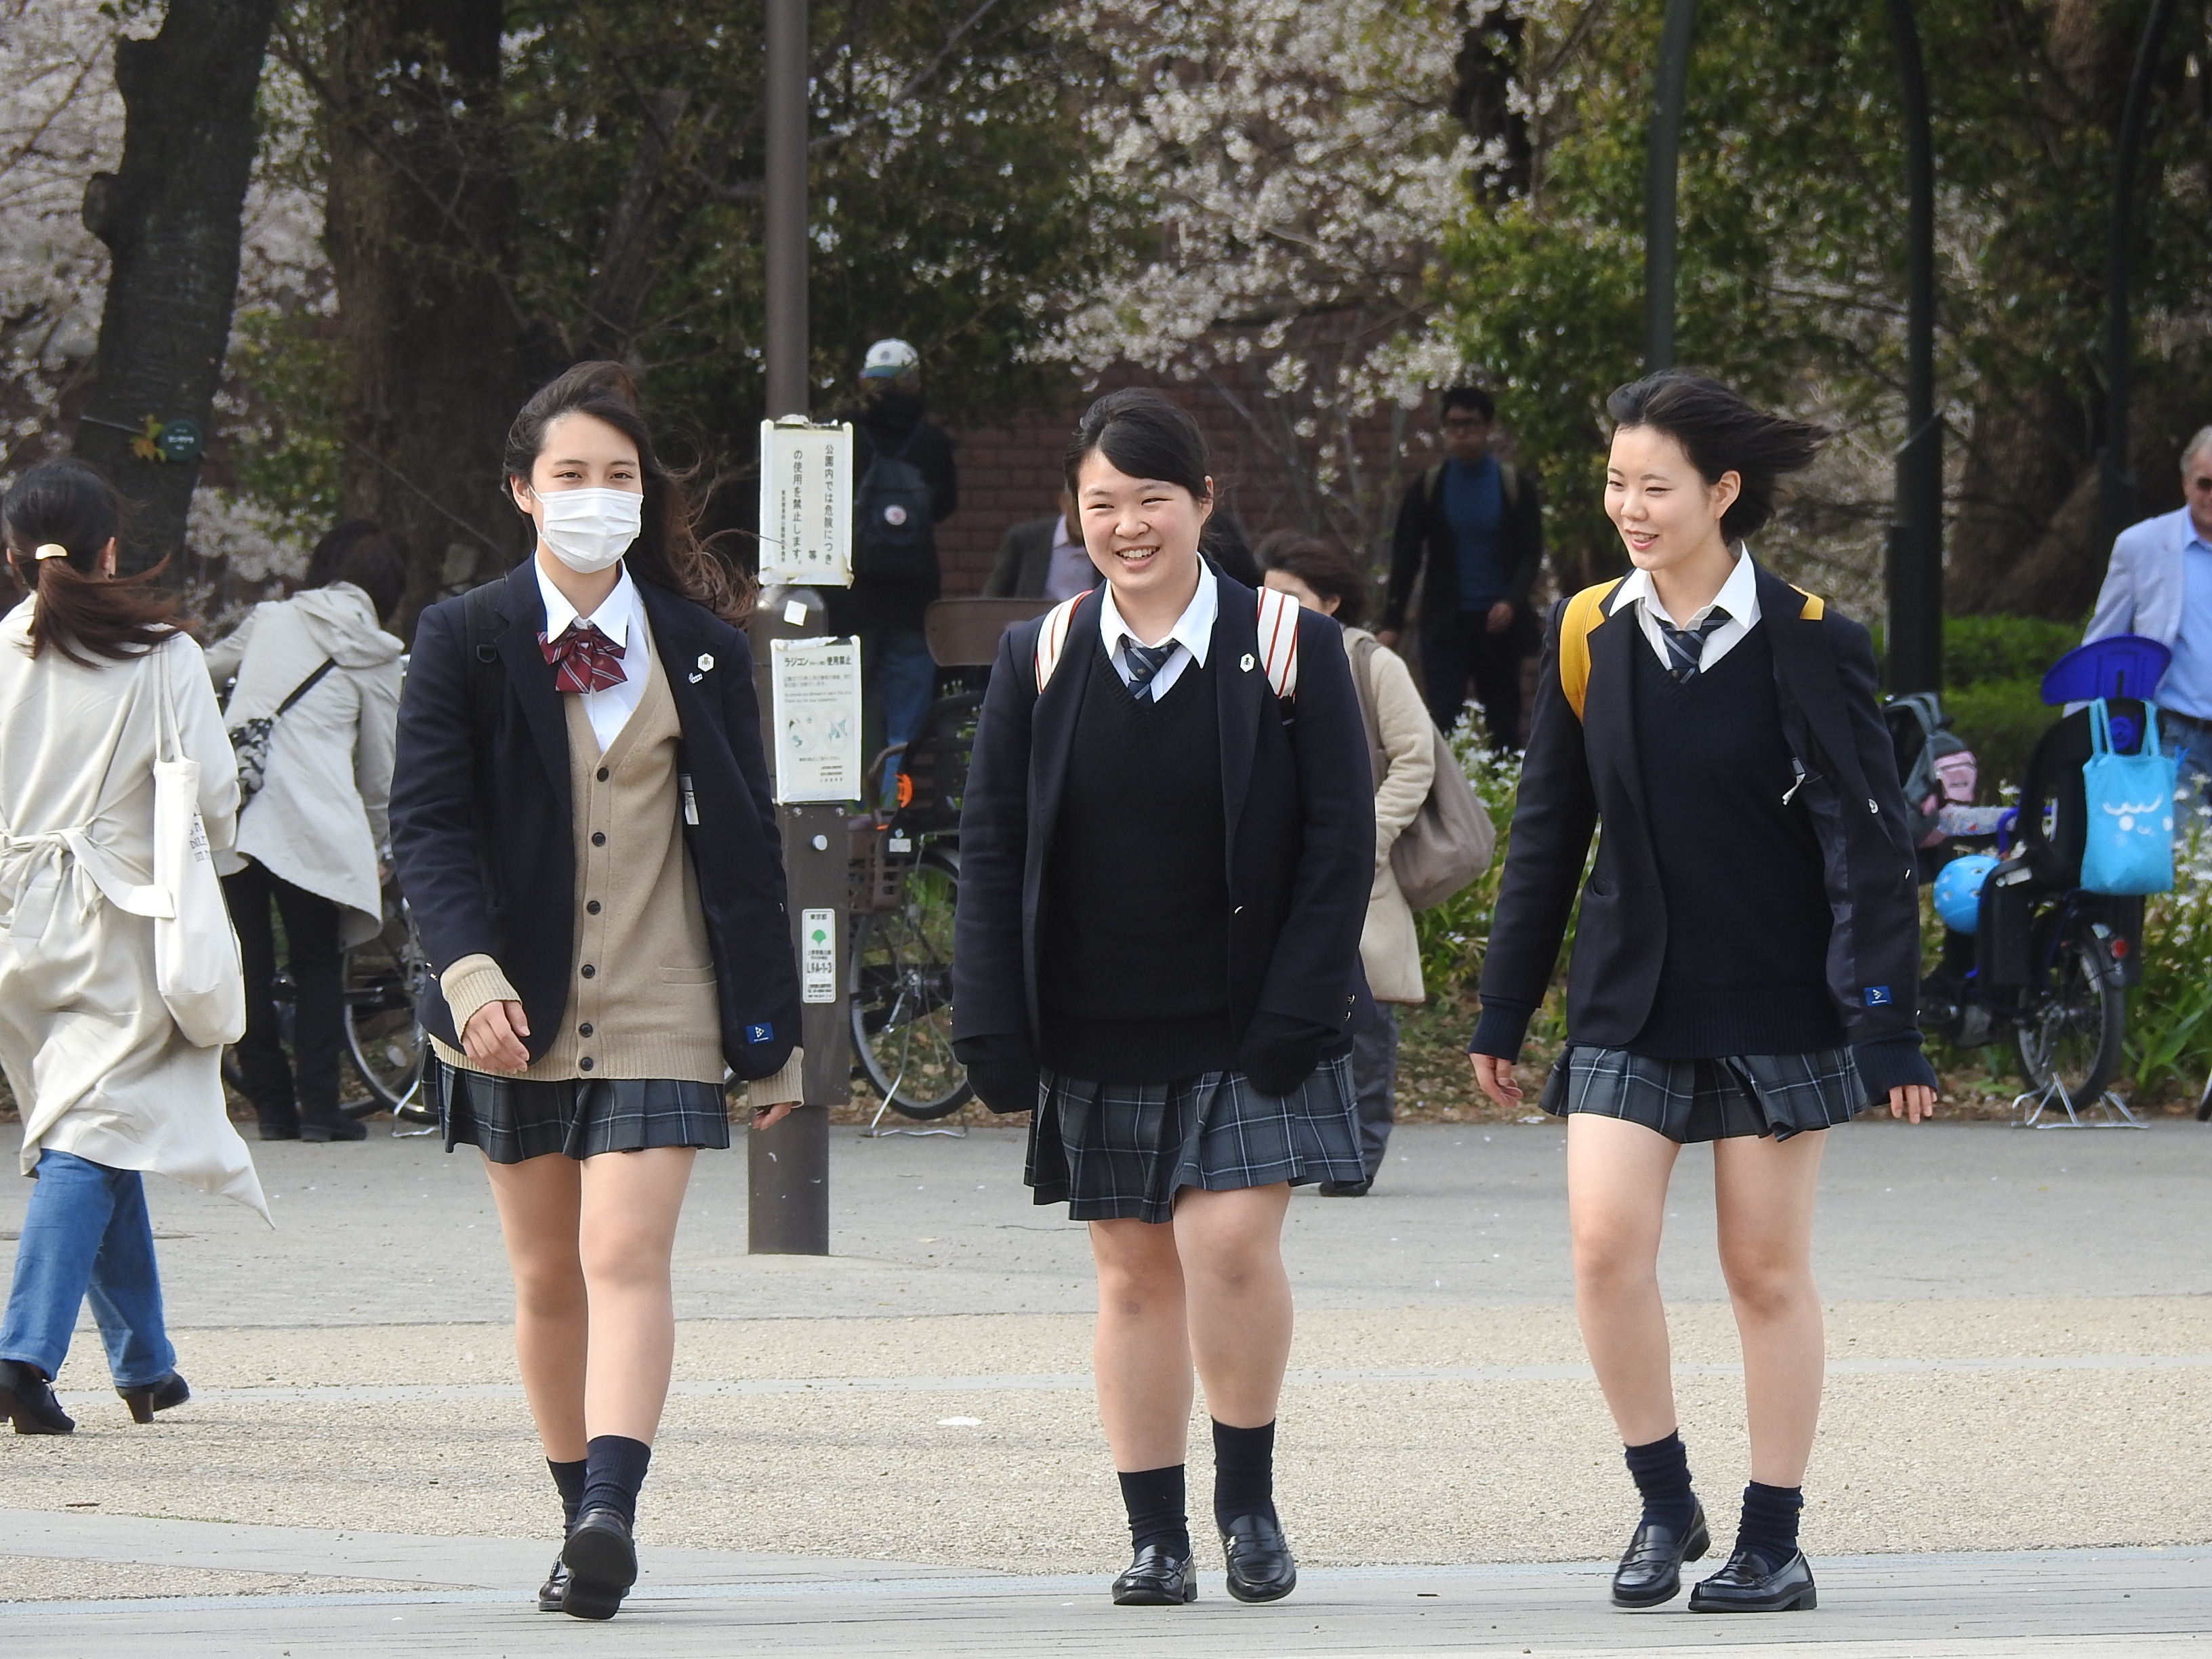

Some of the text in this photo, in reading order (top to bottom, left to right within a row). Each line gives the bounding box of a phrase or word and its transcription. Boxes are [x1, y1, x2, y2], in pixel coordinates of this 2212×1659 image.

[792, 450, 803, 565] の使用を禁止します。
[808, 550, 817, 561] 等
[824, 444, 834, 565] 公園内では危険につき
